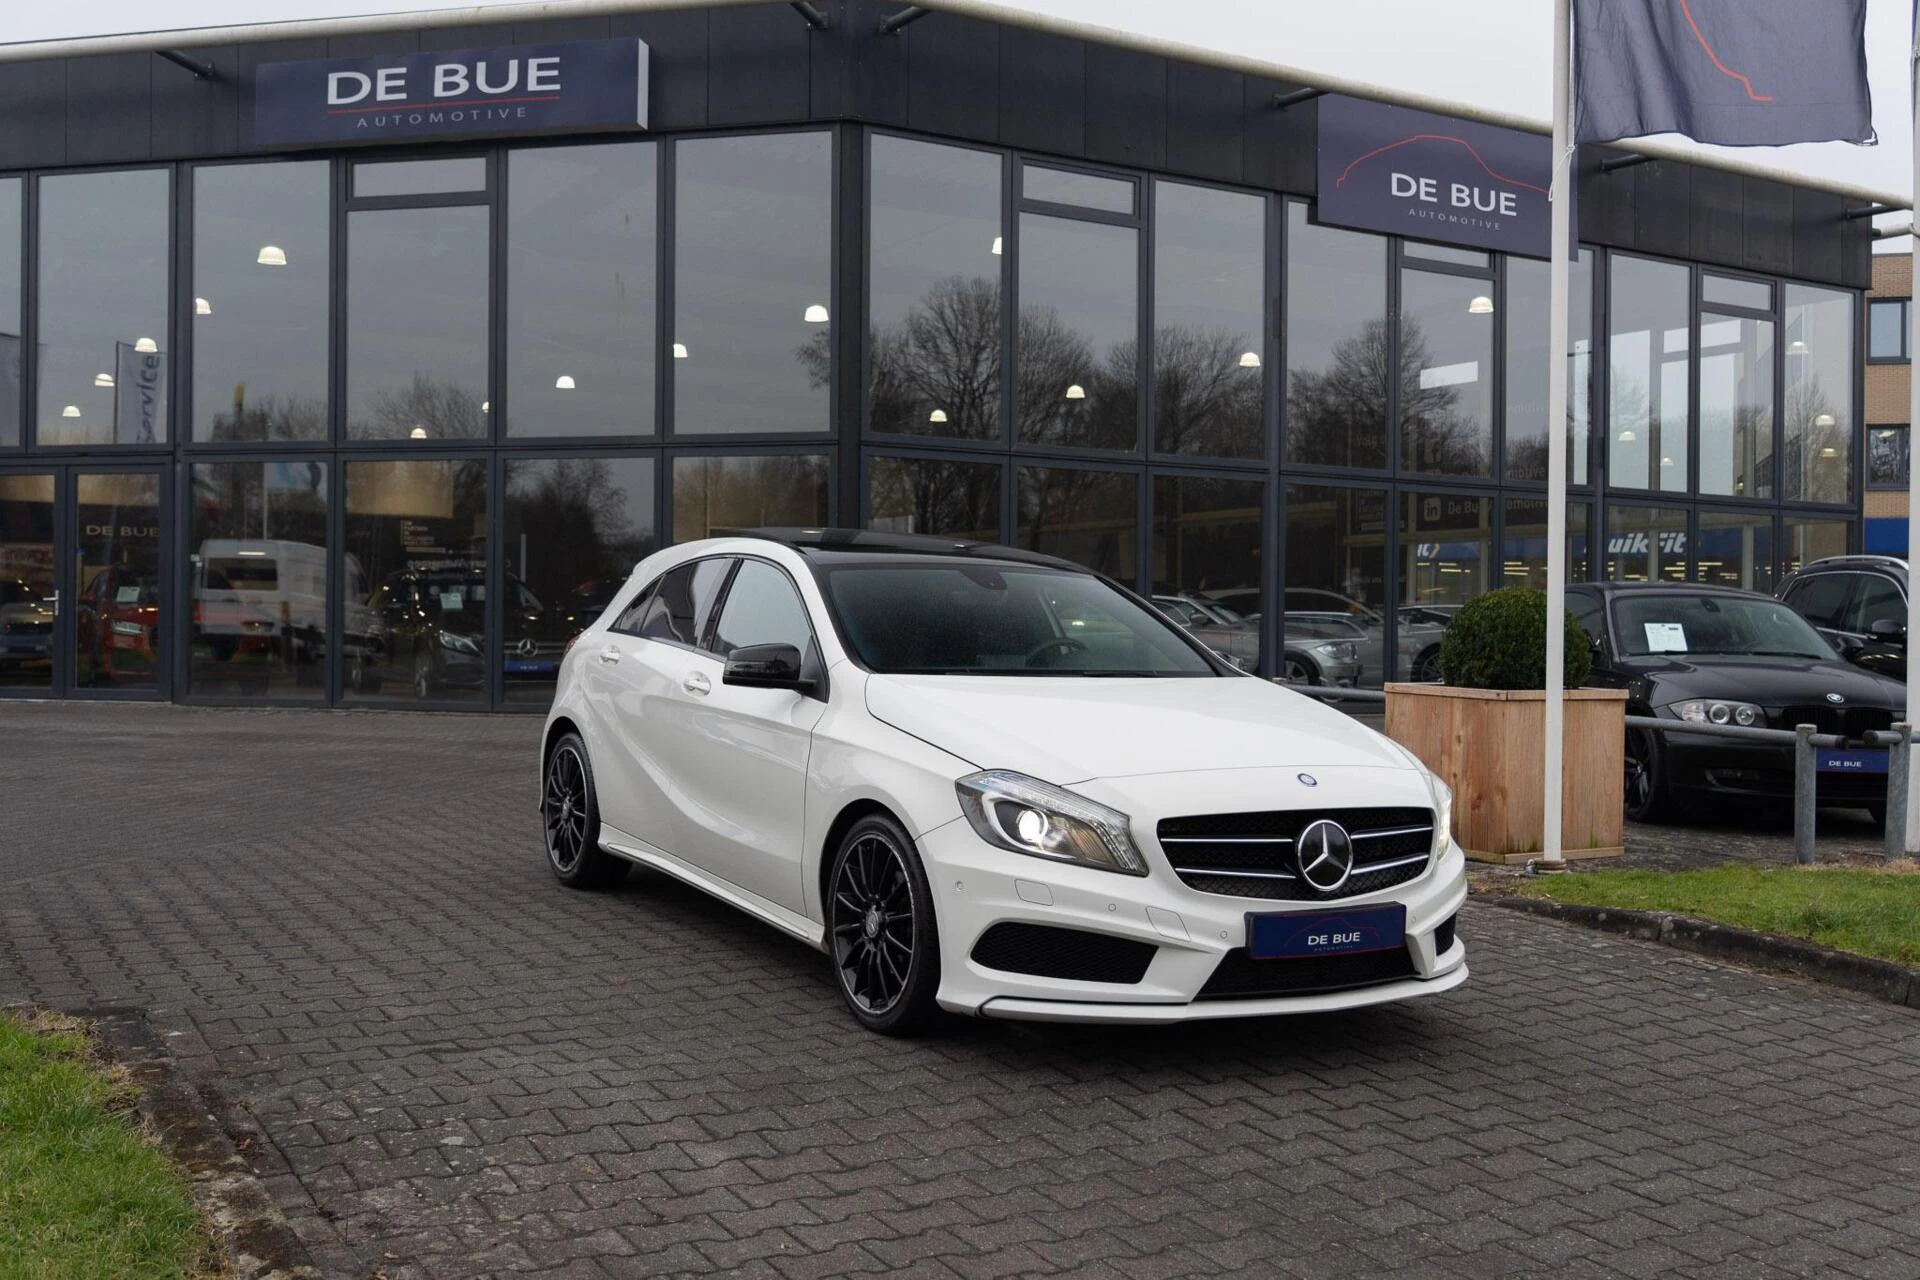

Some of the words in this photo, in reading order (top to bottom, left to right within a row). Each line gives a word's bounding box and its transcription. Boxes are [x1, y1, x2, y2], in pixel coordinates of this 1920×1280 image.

[327, 66, 408, 105] DE
[433, 56, 562, 98] BUE
[356, 106, 528, 129] AUTOMOTIVE
[1391, 172, 1438, 203] DE
[1450, 183, 1518, 217] BUE
[1408, 208, 1501, 231] AUTOMOTIVE
[1447, 501, 1461, 514] De
[1464, 500, 1479, 513] Bu
[86, 524, 114, 536] DE
[121, 526, 161, 537] BUE
[1843, 760, 1862, 768] BUE
[1307, 934, 1328, 945] DE
[1332, 932, 1361, 944] BUE
